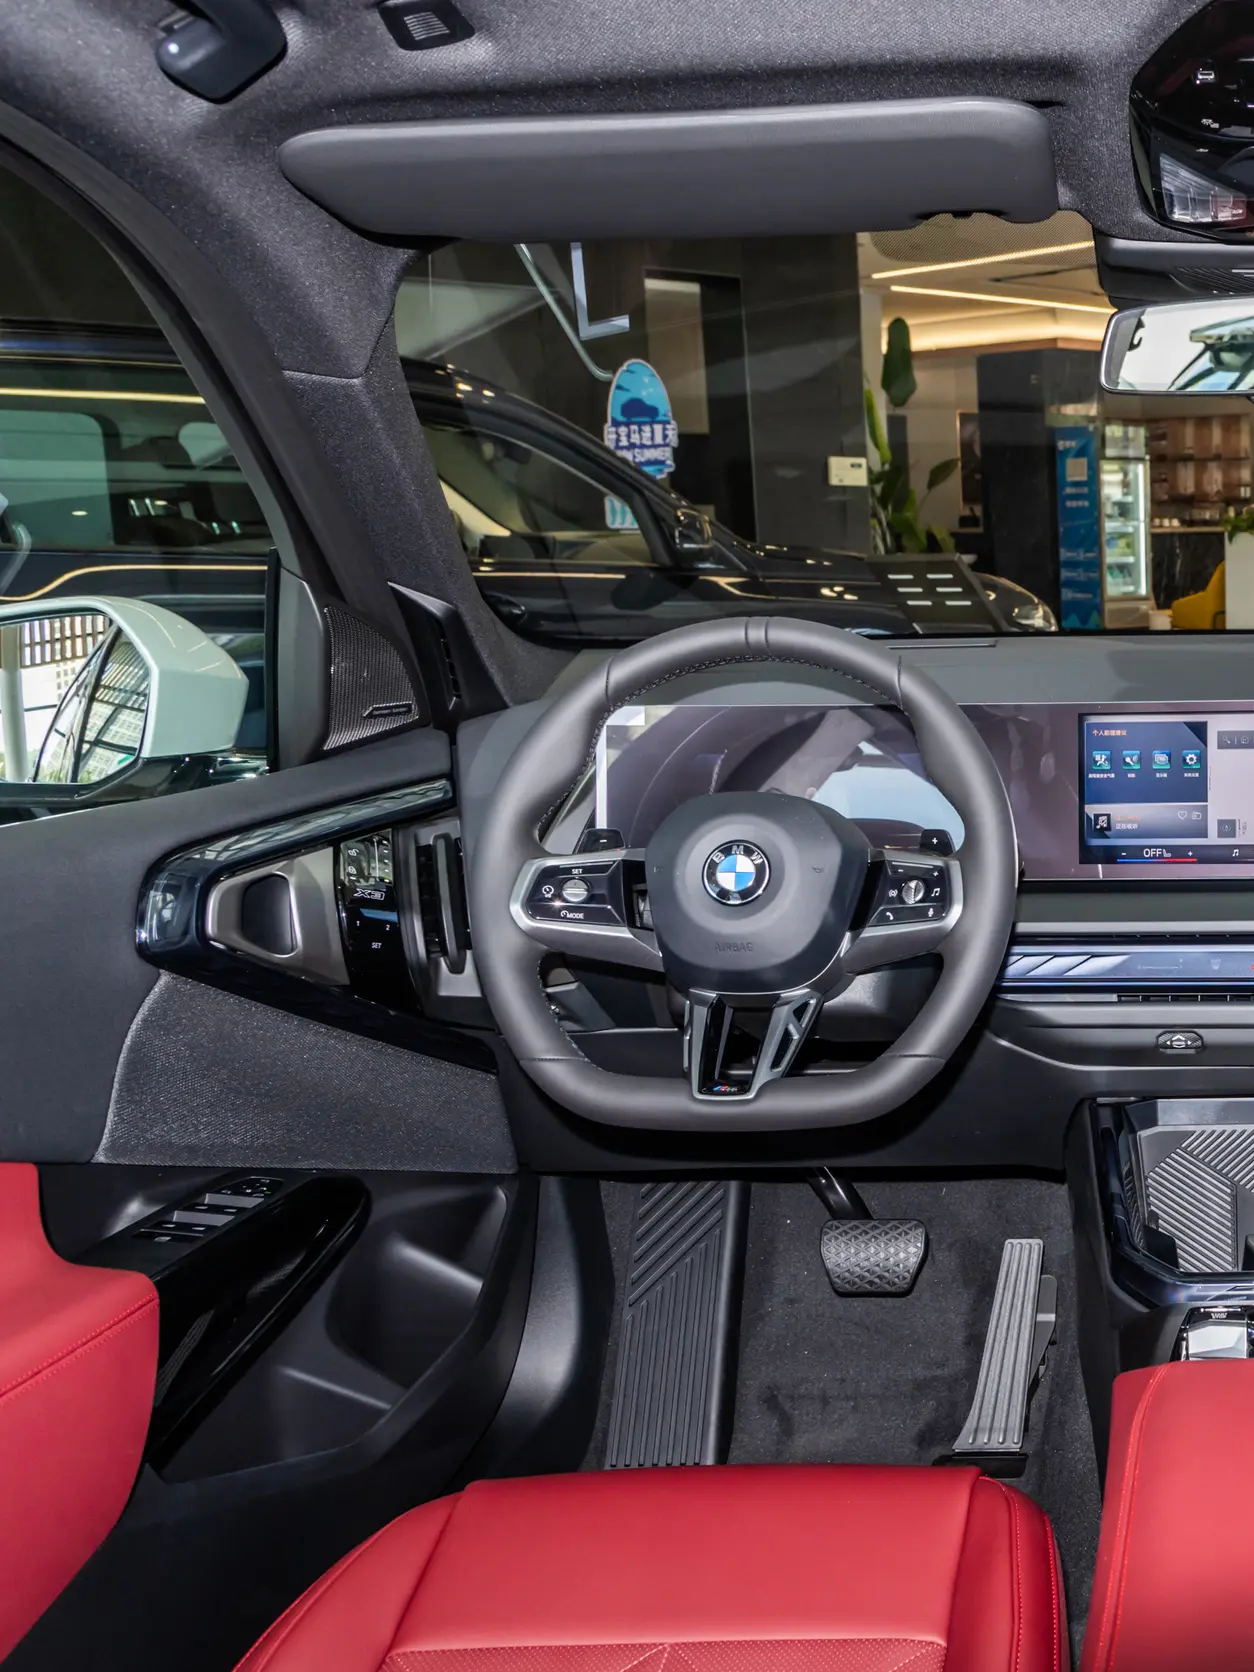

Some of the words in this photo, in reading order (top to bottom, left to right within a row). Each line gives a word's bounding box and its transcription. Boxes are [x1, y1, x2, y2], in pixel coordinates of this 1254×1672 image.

[712, 845, 763, 864] BMW
[1143, 848, 1162, 857] OFF
[353, 888, 385, 900] X3
[714, 941, 754, 952] AIRBAG
